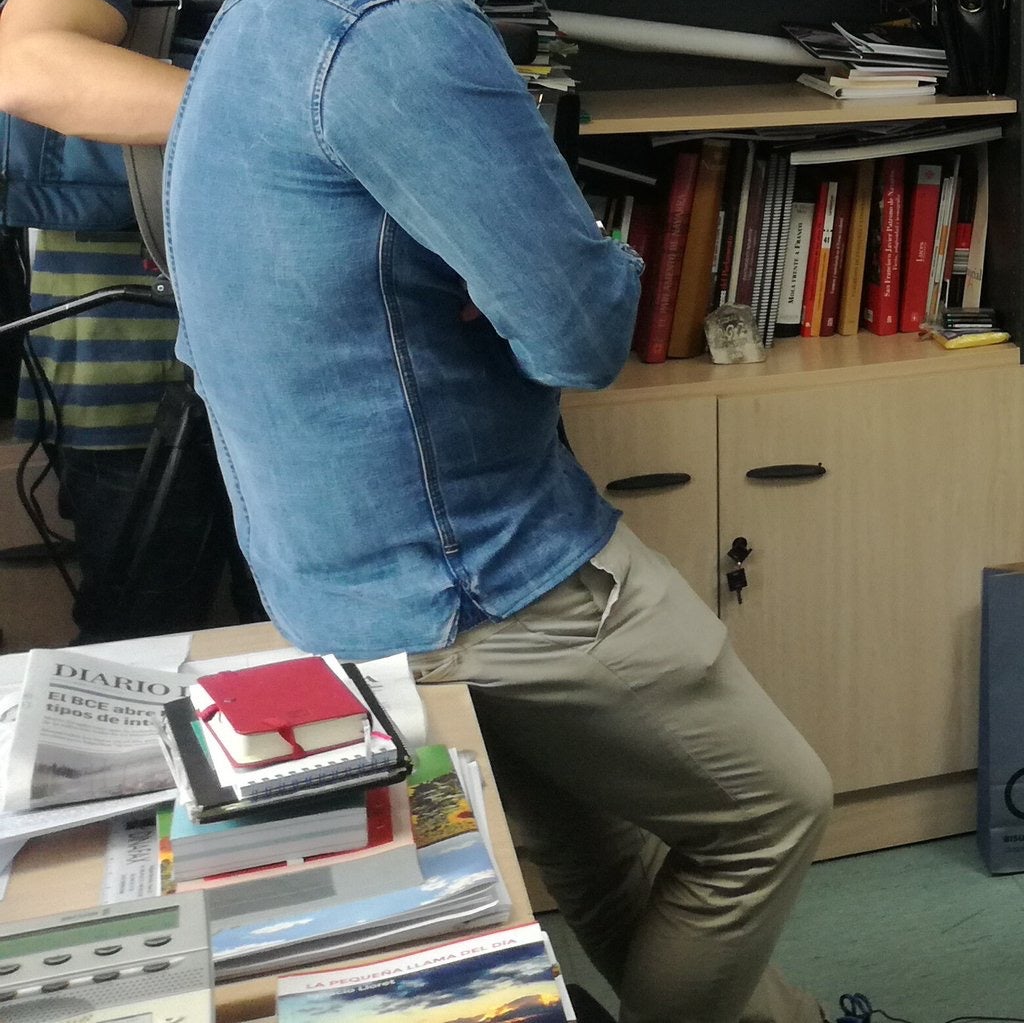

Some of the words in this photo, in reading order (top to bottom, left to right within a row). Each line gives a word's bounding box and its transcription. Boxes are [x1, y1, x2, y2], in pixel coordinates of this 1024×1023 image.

[671, 194, 687, 236] NAVARRA
[886, 206, 894, 232] Patrono
[885, 233, 894, 252] Javier
[884, 253, 892, 284] Francisco
[883, 284, 891, 297] San
[54, 663, 171, 697] DIARIO
[46, 703, 93, 720] tipos
[97, 713, 120, 725] de
[48, 691, 67, 702] El
[71, 696, 110, 710] BCE
[113, 705, 156, 718] abre
[305, 981, 325, 989] LA
[328, 967, 402, 987] PEQUEÑA
[406, 953, 458, 972] LLAMA
[459, 945, 489, 957] DEL
[491, 937, 518, 950] DÍA
